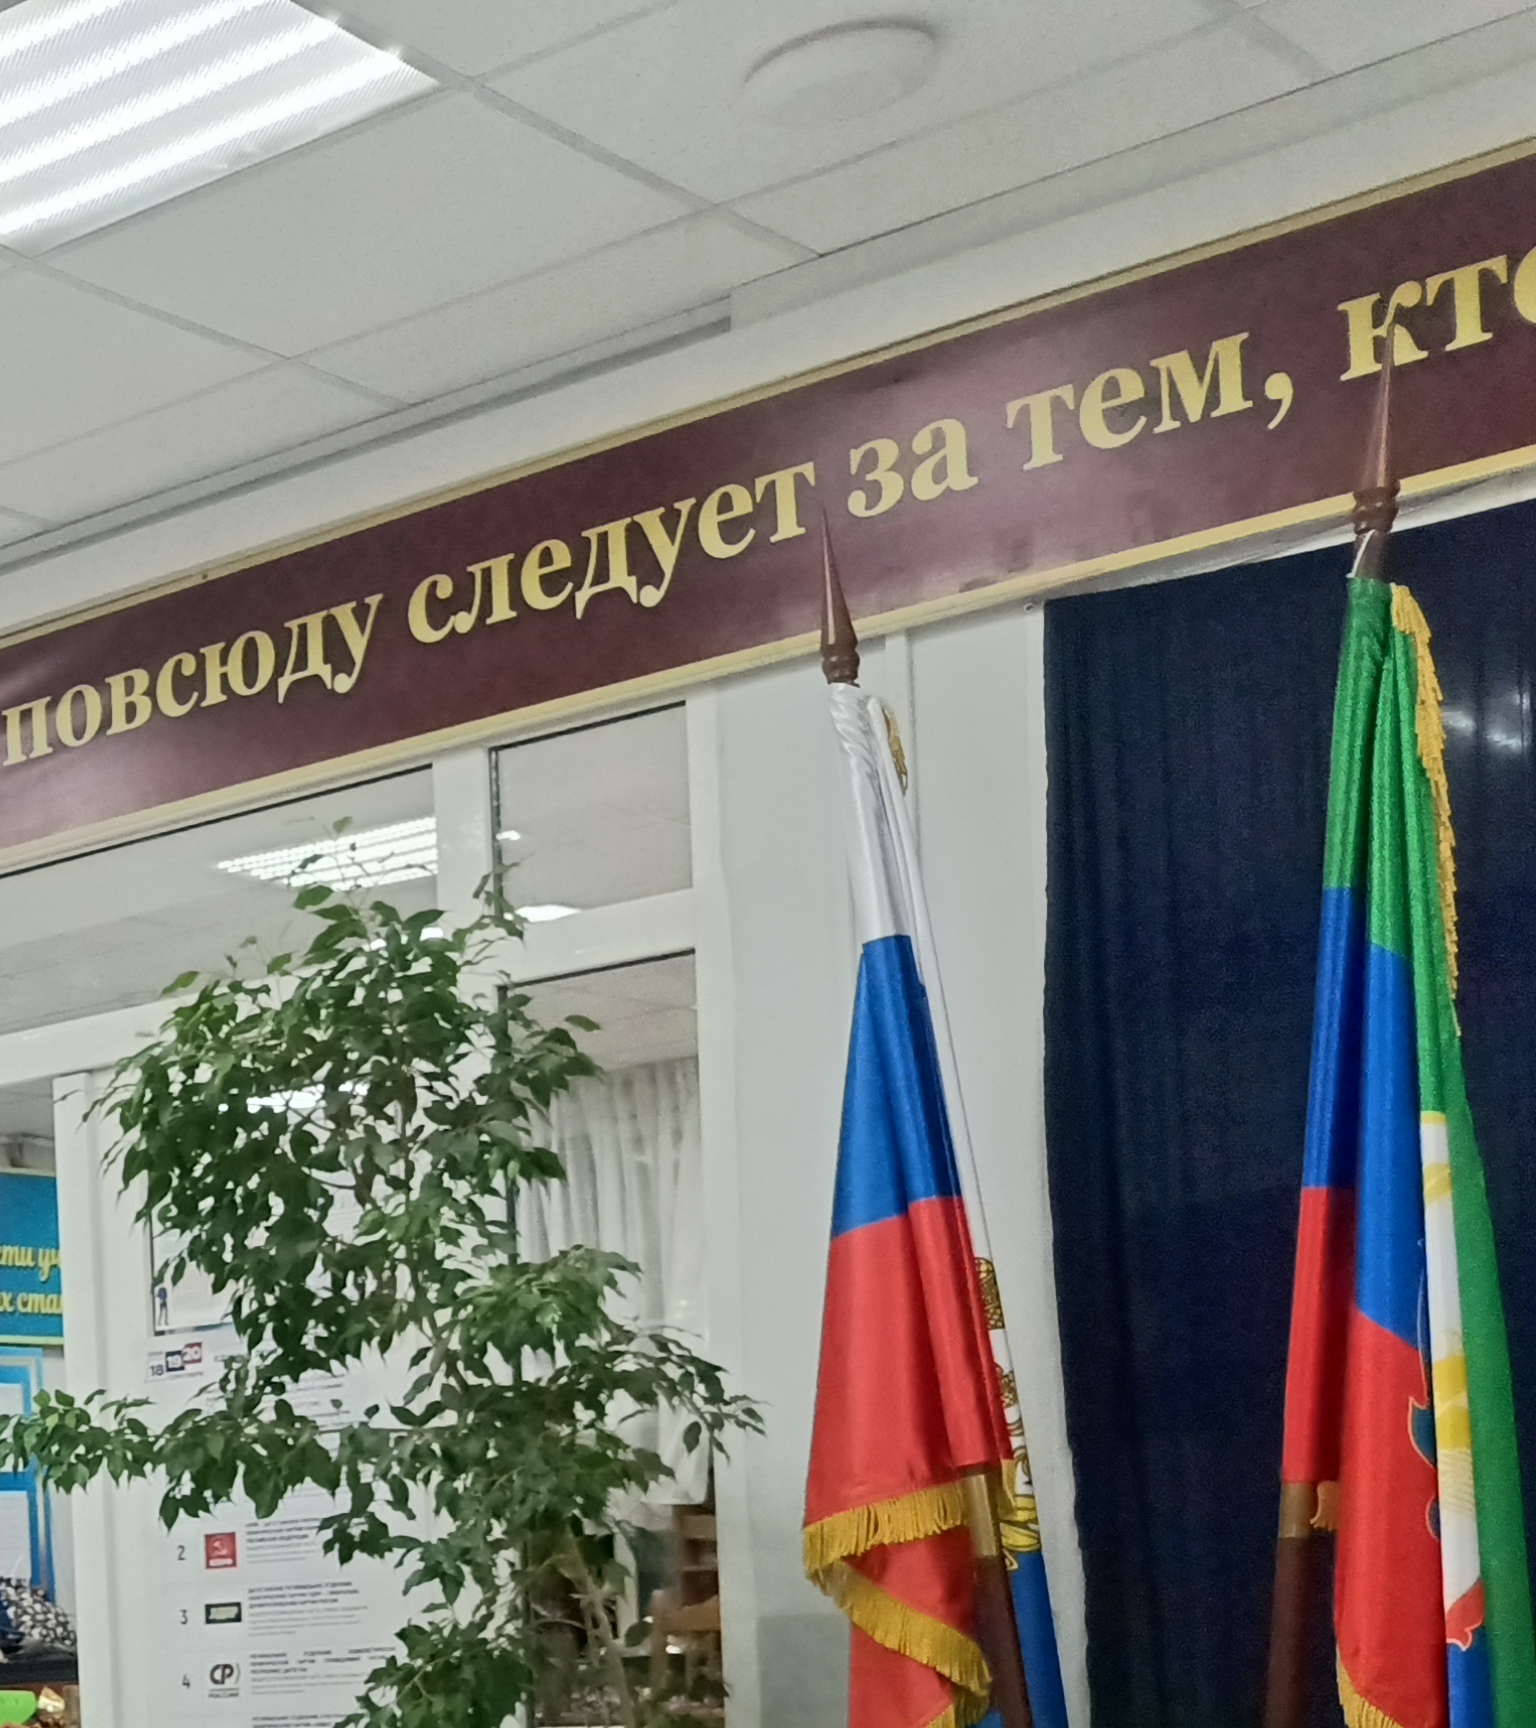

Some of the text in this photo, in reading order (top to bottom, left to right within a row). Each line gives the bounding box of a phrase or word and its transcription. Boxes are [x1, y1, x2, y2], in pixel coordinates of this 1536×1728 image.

[1, 594, 384, 766] повсюду
[407, 461, 816, 645] следует
[847, 417, 979, 520] за
[1004, 331, 1294, 473] тем,
[17, 1292, 63, 1314] ста
[177, 1544, 186, 1561] 2
[179, 1609, 188, 1625] 3
[182, 1673, 191, 1689] 4
